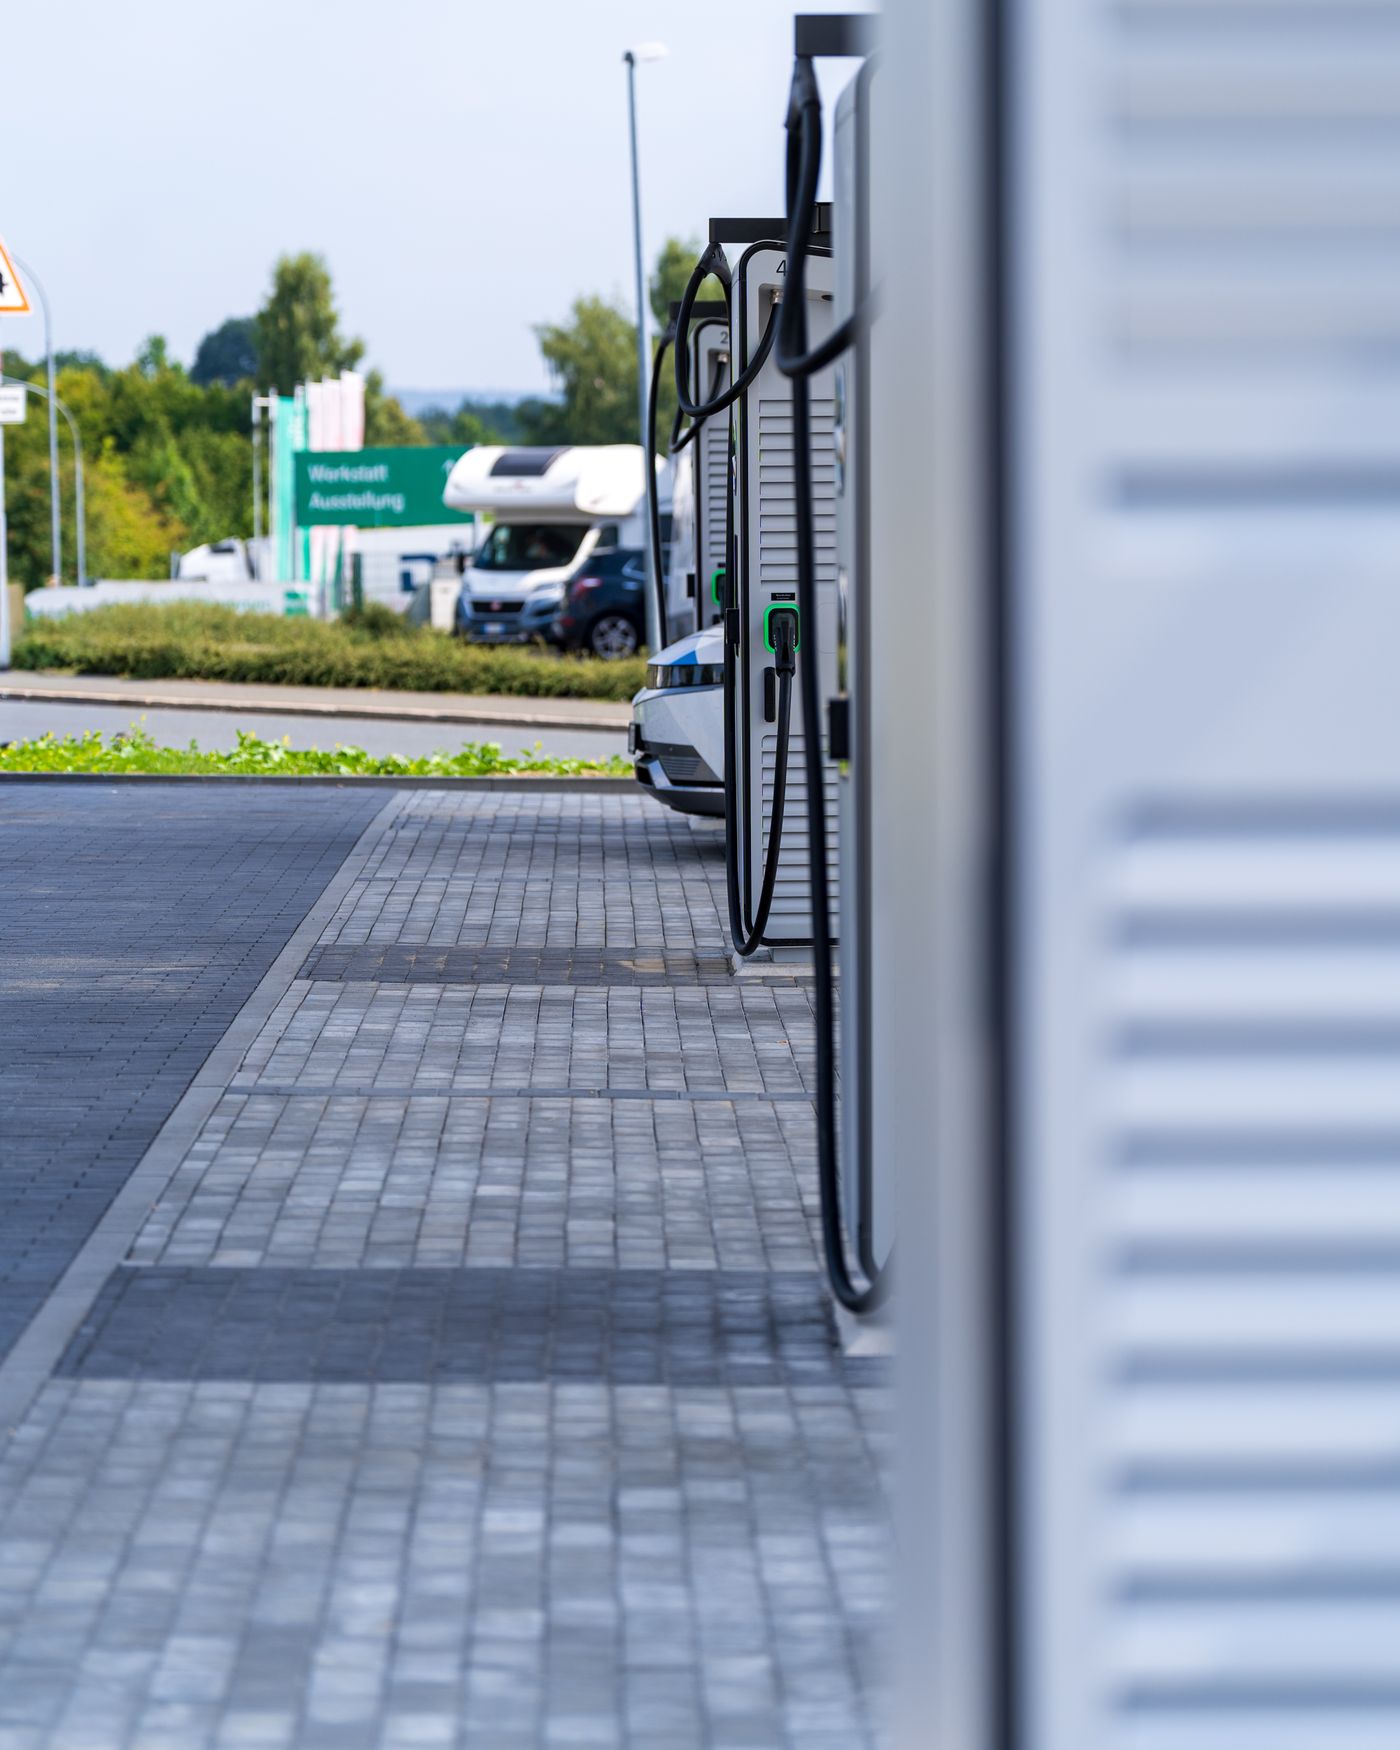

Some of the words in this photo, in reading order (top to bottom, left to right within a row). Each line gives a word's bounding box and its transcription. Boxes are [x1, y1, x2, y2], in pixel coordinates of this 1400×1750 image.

[776, 259, 788, 277] 4
[720, 331, 729, 344] 2
[308, 464, 388, 482] Werkstatt
[309, 491, 405, 513] Ausstellung
